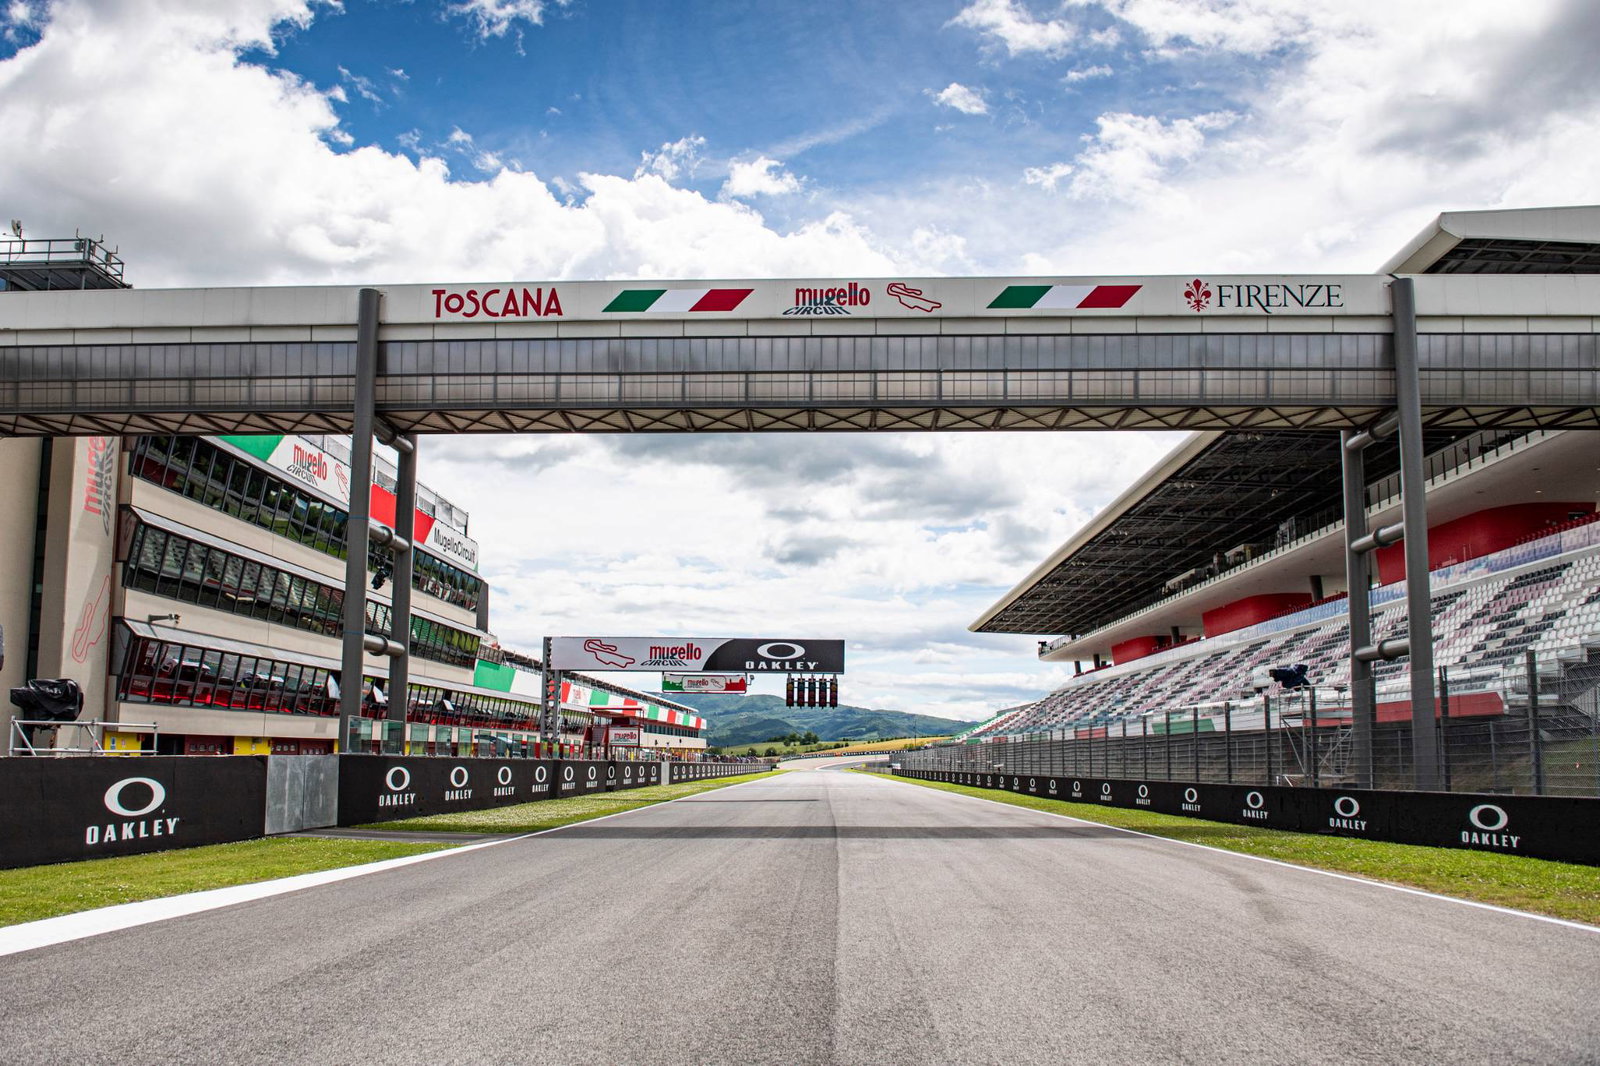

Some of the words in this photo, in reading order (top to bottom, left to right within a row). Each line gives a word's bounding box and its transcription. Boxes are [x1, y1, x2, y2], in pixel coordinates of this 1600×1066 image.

[795, 282, 871, 306] mugello
[1216, 284, 1344, 314] FIRENZE
[782, 306, 852, 316] CIRCUIT
[293, 443, 328, 480] mugello
[286, 463, 318, 487] CIRCUIT
[433, 527, 476, 564] MugelloCircuit
[649, 642, 702, 660] mugello
[640, 659, 688, 667] CIRCUIT
[745, 661, 819, 670] OAKLEY
[445, 789, 473, 801] OAKLEY
[493, 786, 515, 797] OAKLEY
[379, 793, 416, 807] OAKLEY
[1182, 802, 1201, 812] OAKLEY
[1242, 809, 1268, 820] OAKLEY
[1329, 817, 1367, 831] OAKLEY
[85, 818, 179, 845] OAKLEY
[1461, 831, 1520, 848] OAKLEY
